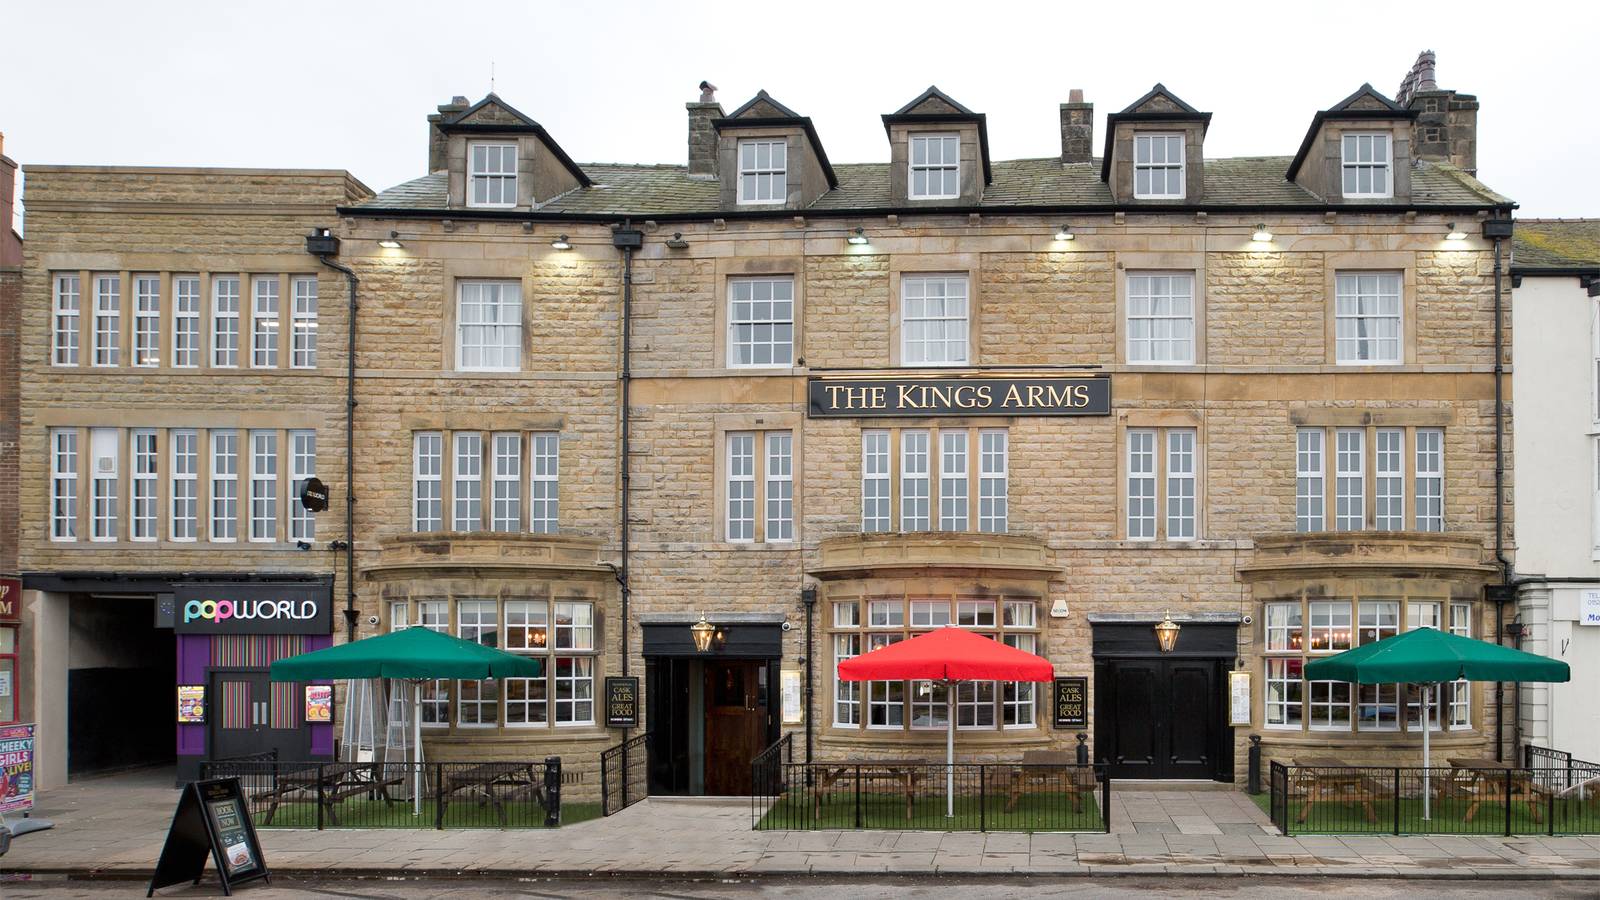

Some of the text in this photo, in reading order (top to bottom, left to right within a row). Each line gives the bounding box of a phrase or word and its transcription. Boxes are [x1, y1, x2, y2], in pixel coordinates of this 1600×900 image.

[825, 384, 1090, 409] THE KINGS ARMS
[611, 694, 633, 702] ALES
[1060, 694, 1082, 702] ALES
[1060, 709, 1082, 717] FOOD
[0, 751, 29, 766] GIRLS
